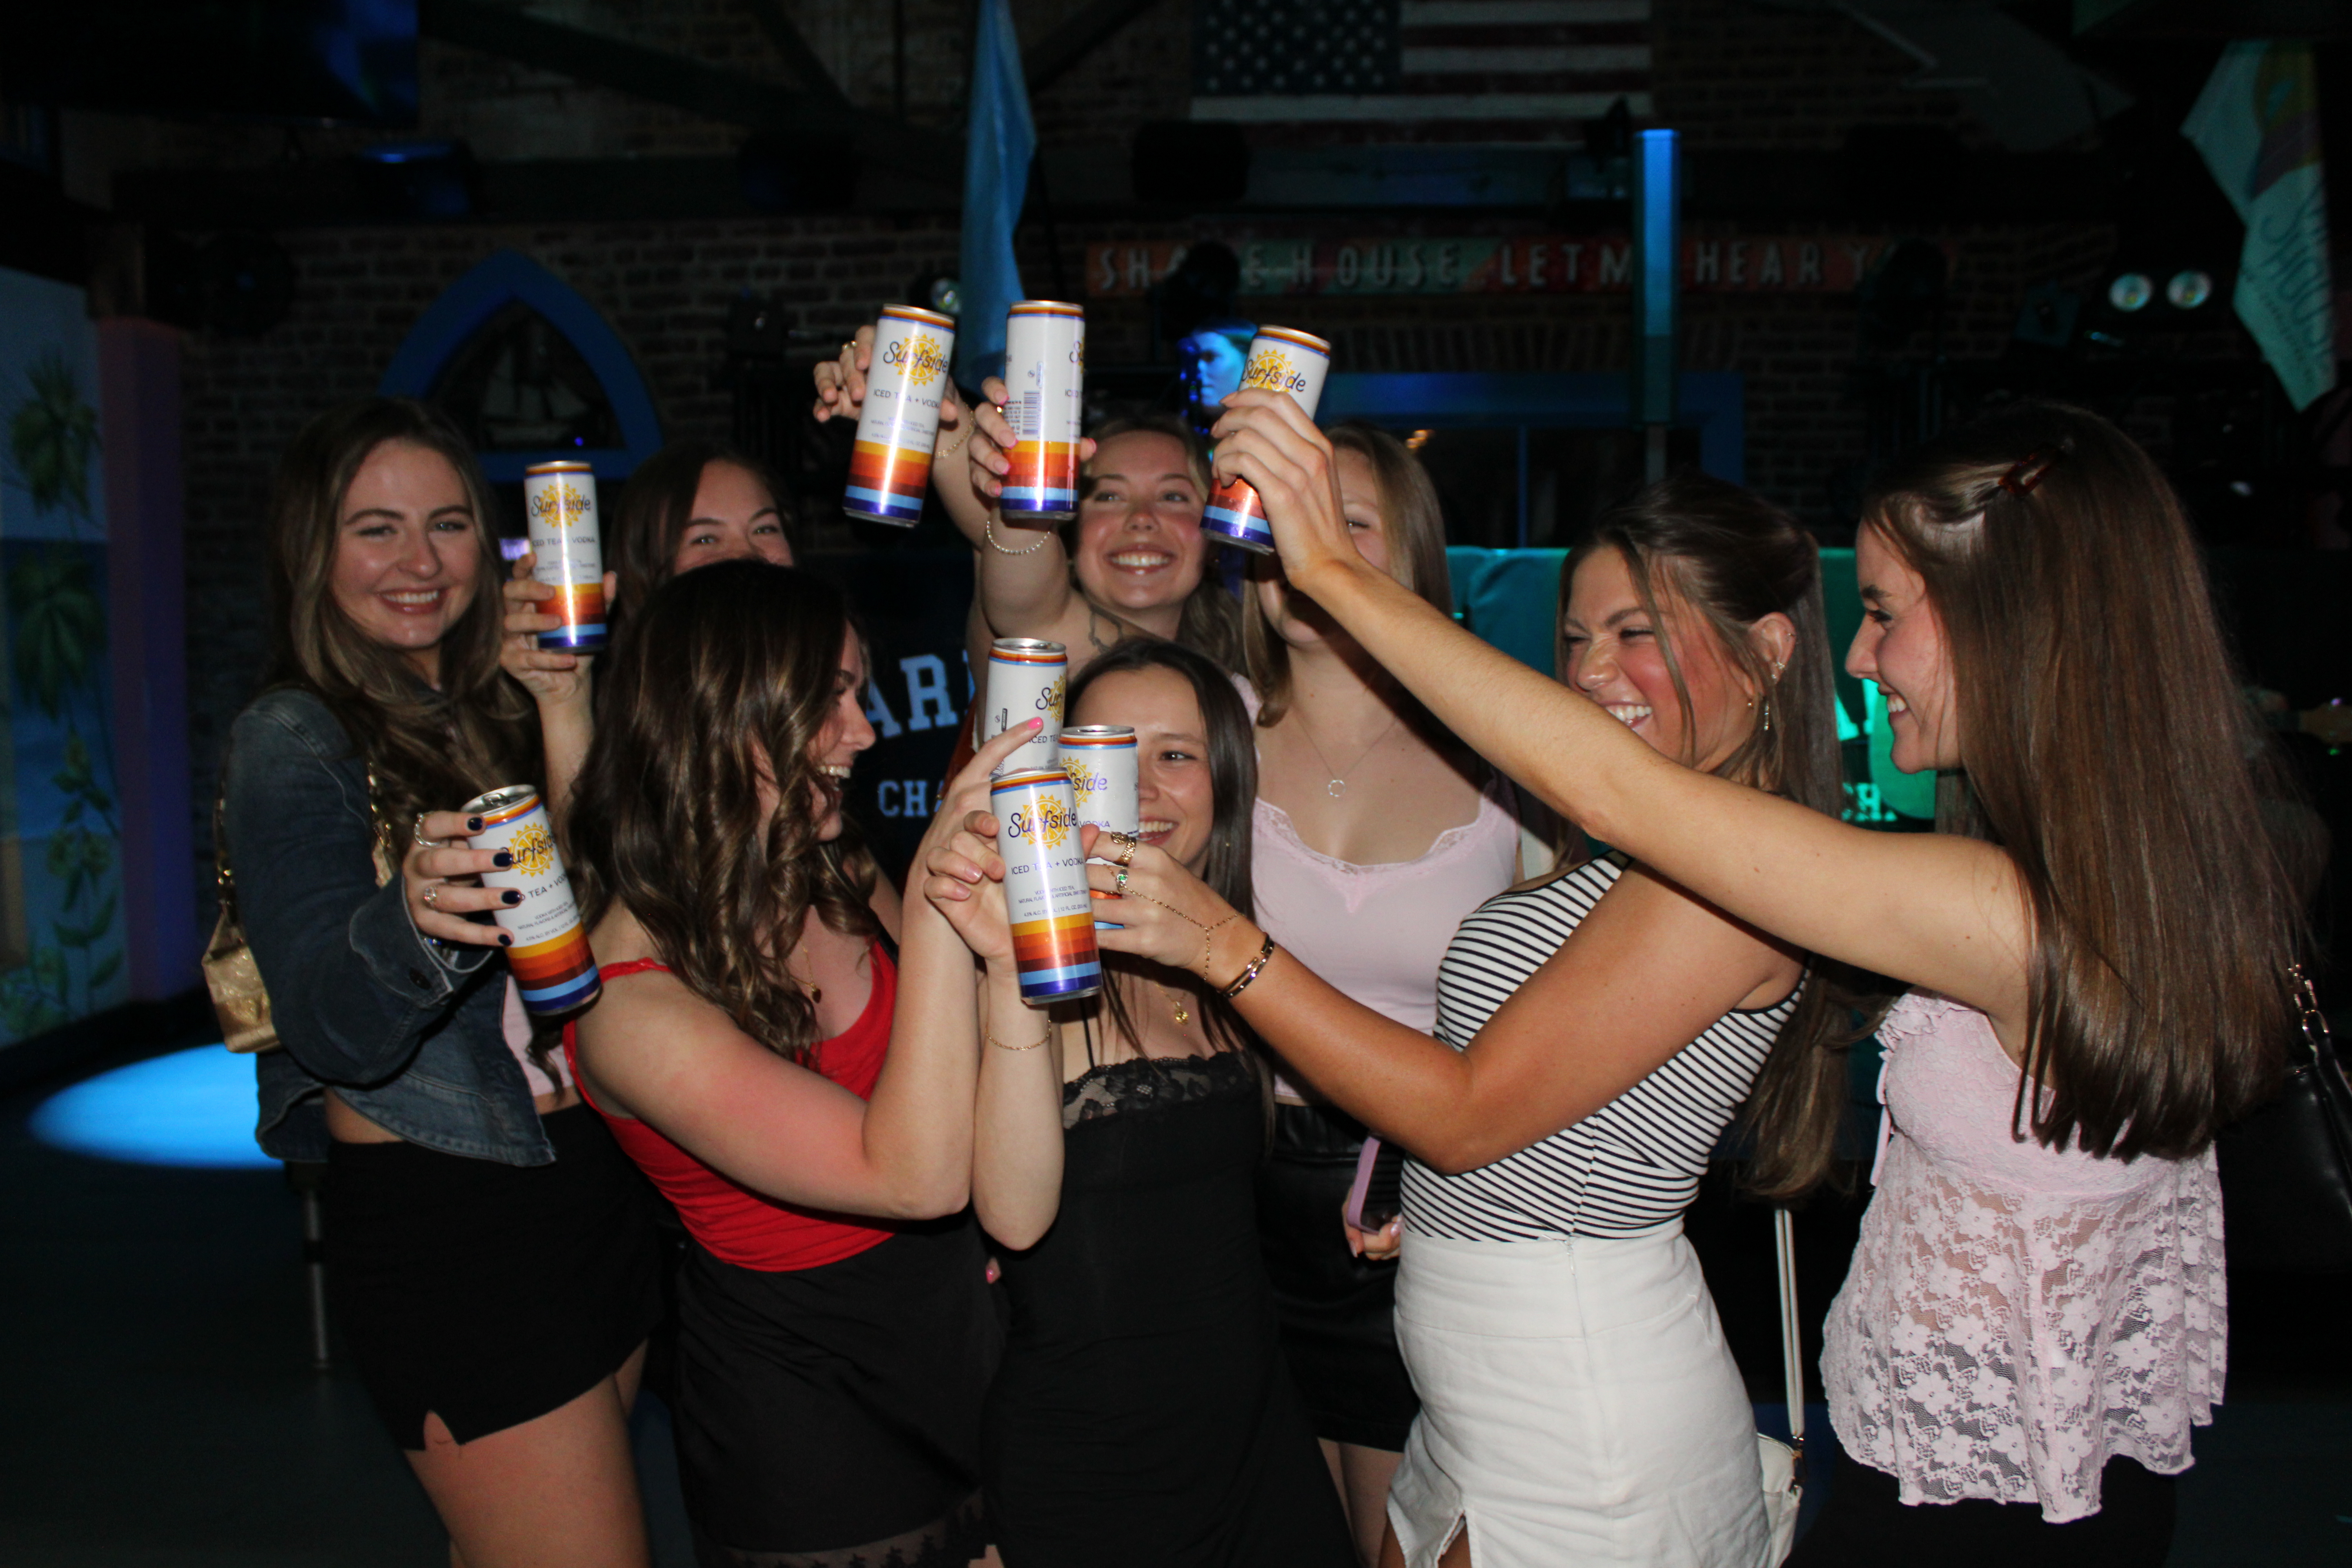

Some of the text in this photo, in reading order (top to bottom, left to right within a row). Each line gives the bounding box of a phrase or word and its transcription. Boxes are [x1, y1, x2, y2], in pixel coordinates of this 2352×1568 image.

[1100, 244, 1263, 289] SHE
[1292, 243, 1460, 287] HOUSE
[1501, 242, 1584, 286] LET
[1599, 243, 1632, 285] M
[1694, 241, 1821, 285] HEAR
[883, 341, 947, 372] Surfside
[1241, 359, 1306, 392] Surfside
[874, 388, 891, 398] ICED
[894, 392, 911, 402] TA
[531, 494, 591, 517] Surfside
[1008, 807, 1077, 838] Surfside
[1011, 865, 1029, 875] ICED
[1032, 862, 1053, 871] TA
[528, 886, 547, 898] TEA
